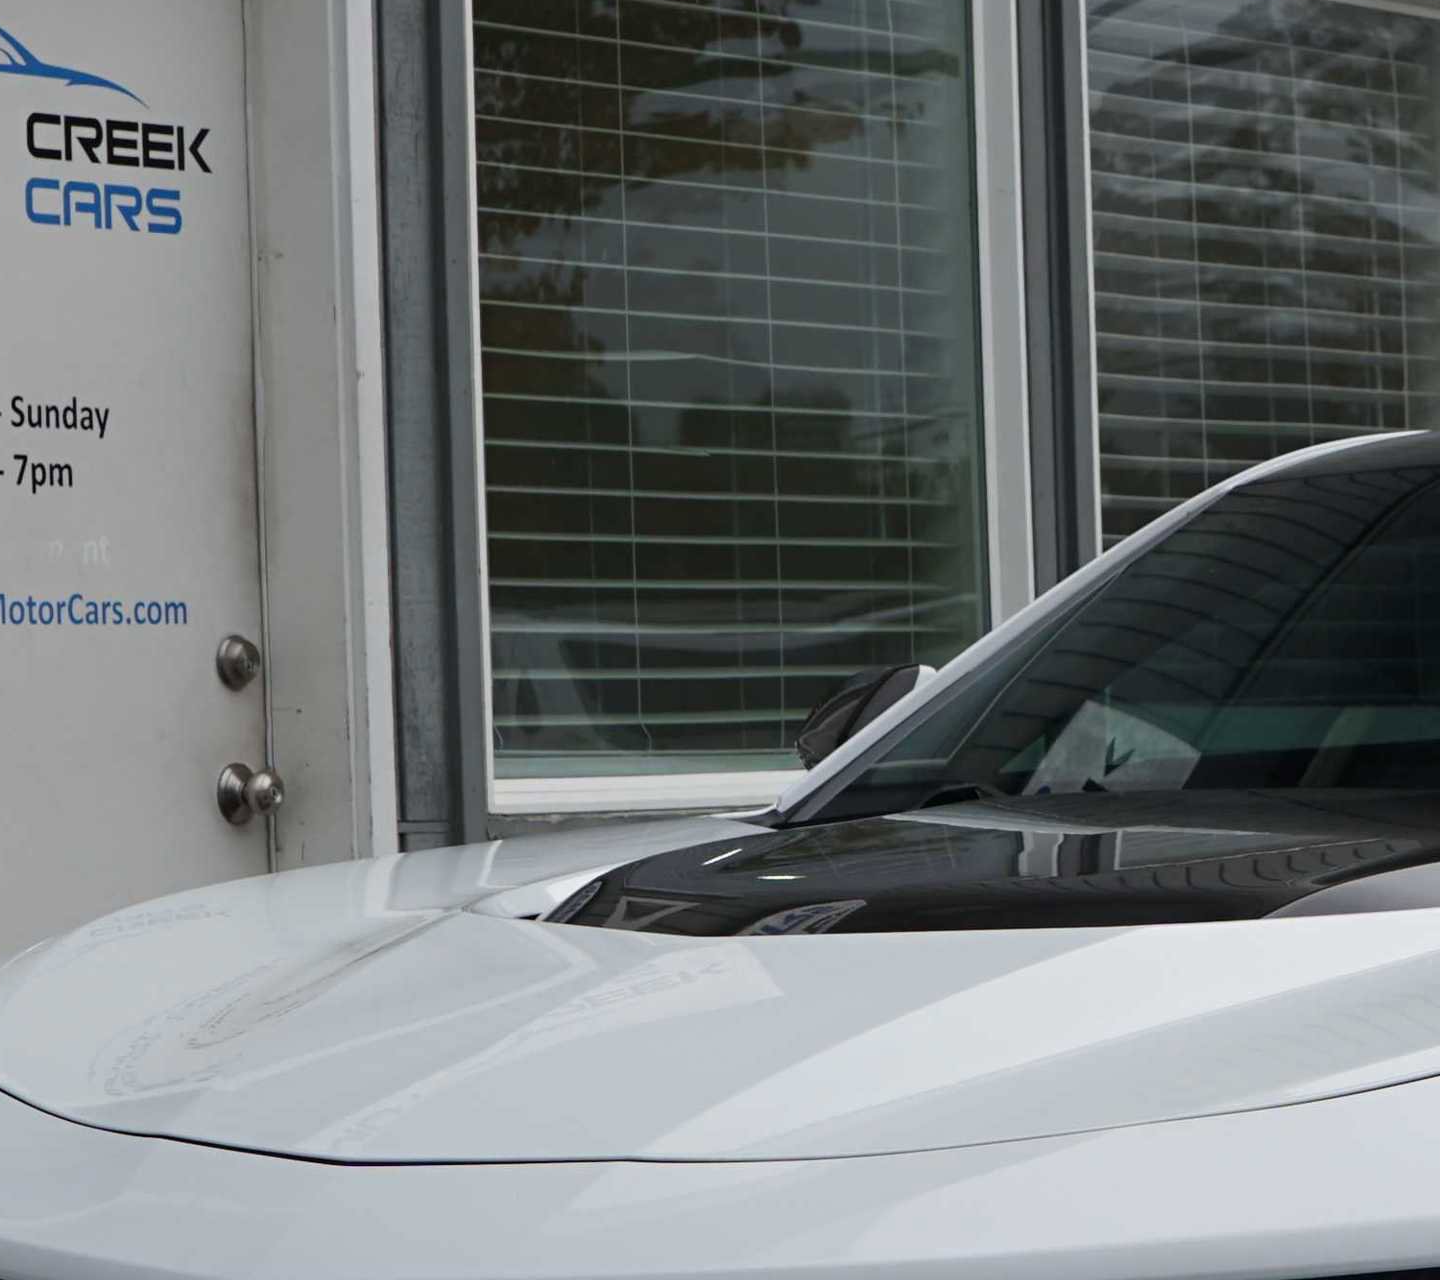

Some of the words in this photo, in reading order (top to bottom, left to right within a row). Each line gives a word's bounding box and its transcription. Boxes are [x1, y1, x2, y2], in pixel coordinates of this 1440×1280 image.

[26, 112, 212, 174] CREEK
[25, 177, 183, 235] CARS
[10, 394, 110, 439] Sunday
[13, 453, 73, 495] 7pm
